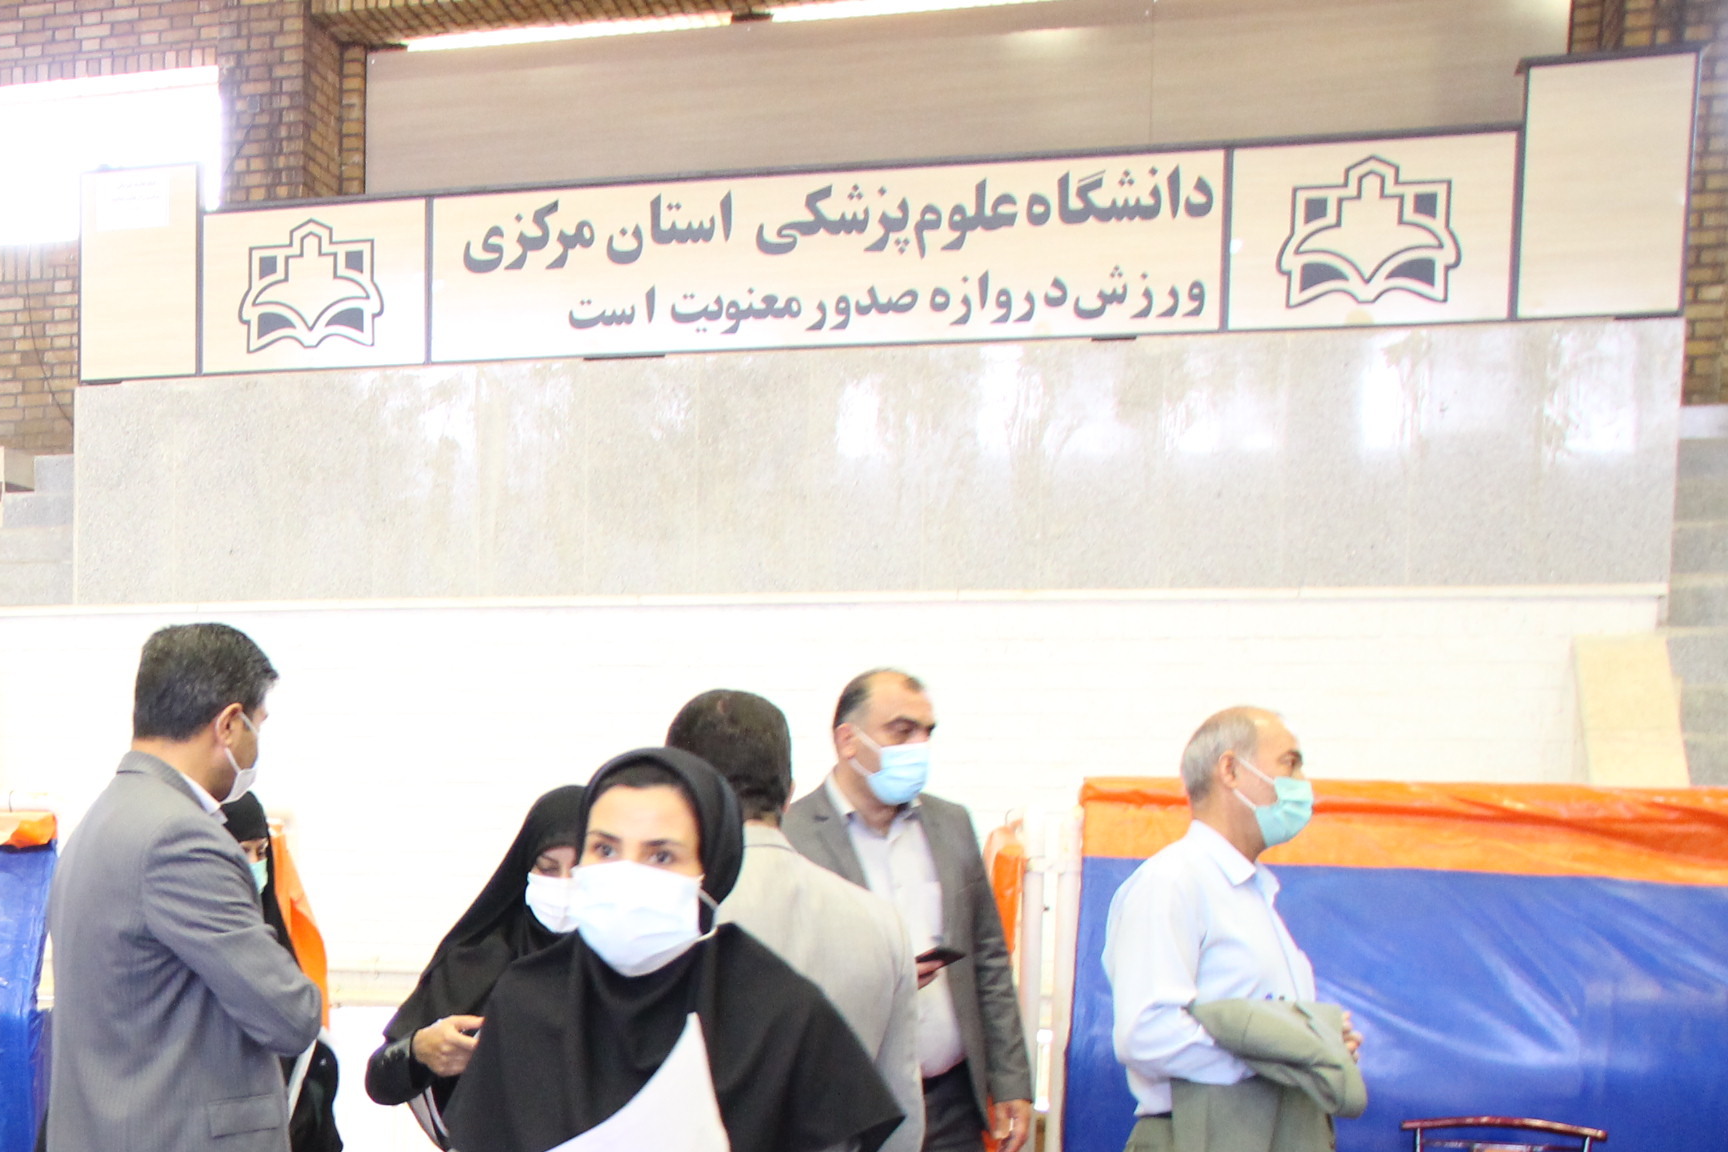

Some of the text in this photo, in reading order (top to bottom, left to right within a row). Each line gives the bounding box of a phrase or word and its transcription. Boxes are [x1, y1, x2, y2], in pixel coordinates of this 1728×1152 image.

[462, 164, 1215, 274] دانشگاه علوم پزشکی استان مرکزی
[568, 264, 1206, 335] ورزش دروازه صدور معنویت است
